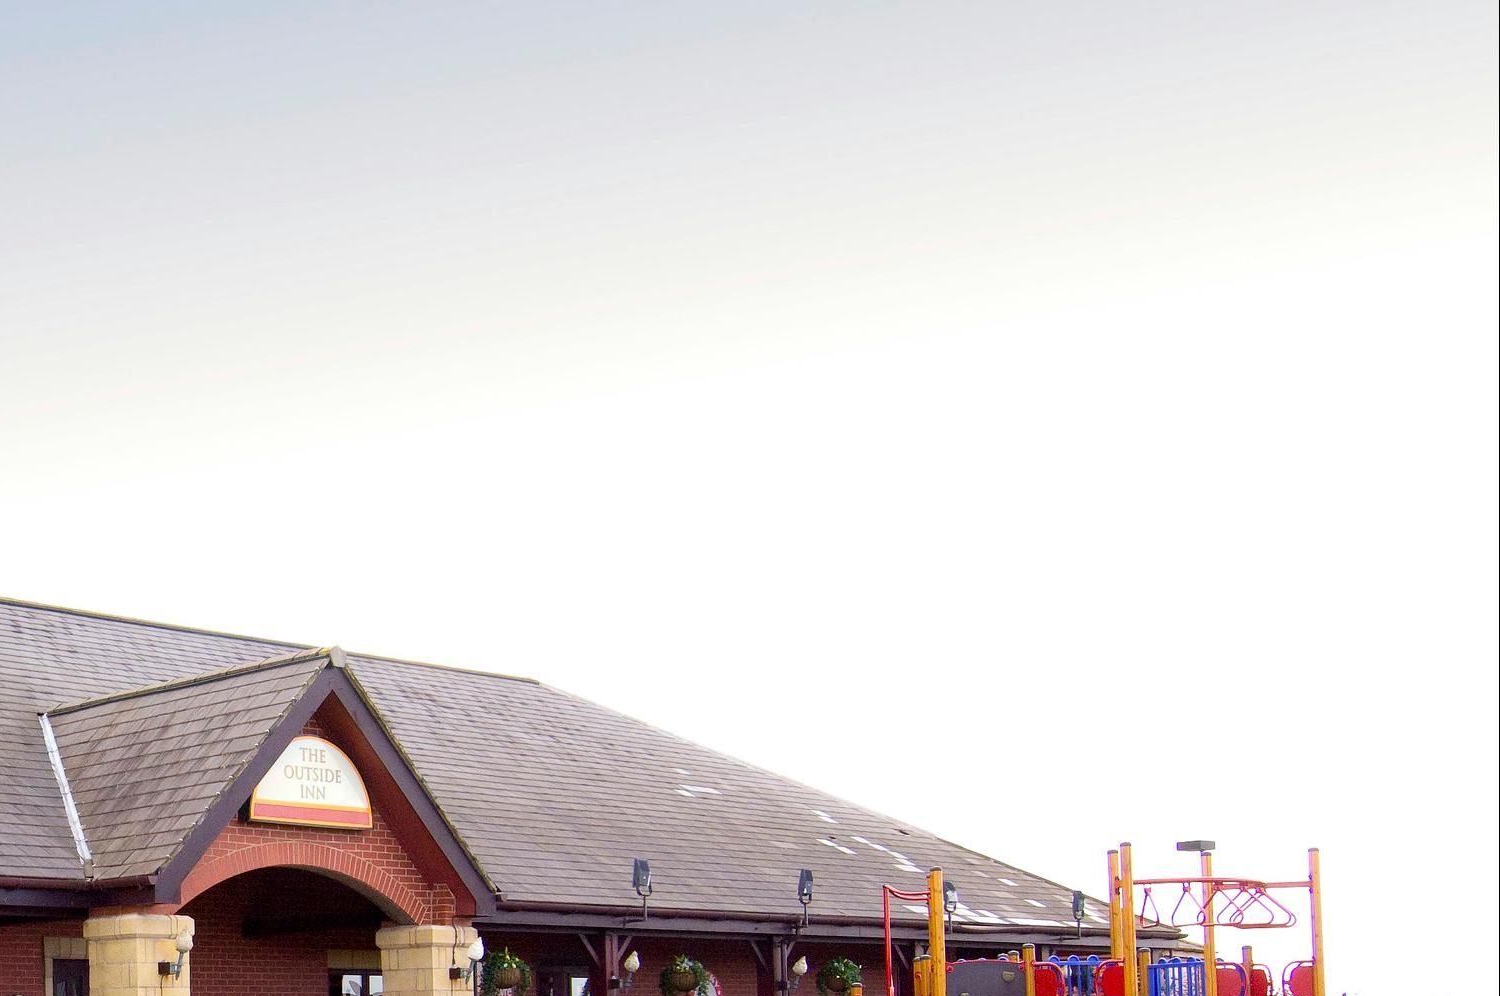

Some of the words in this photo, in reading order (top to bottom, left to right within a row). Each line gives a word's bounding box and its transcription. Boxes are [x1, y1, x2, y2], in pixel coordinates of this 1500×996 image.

[300, 747, 326, 764] THE
[283, 764, 342, 784] OUTSIDE
[300, 783, 327, 801] INN
